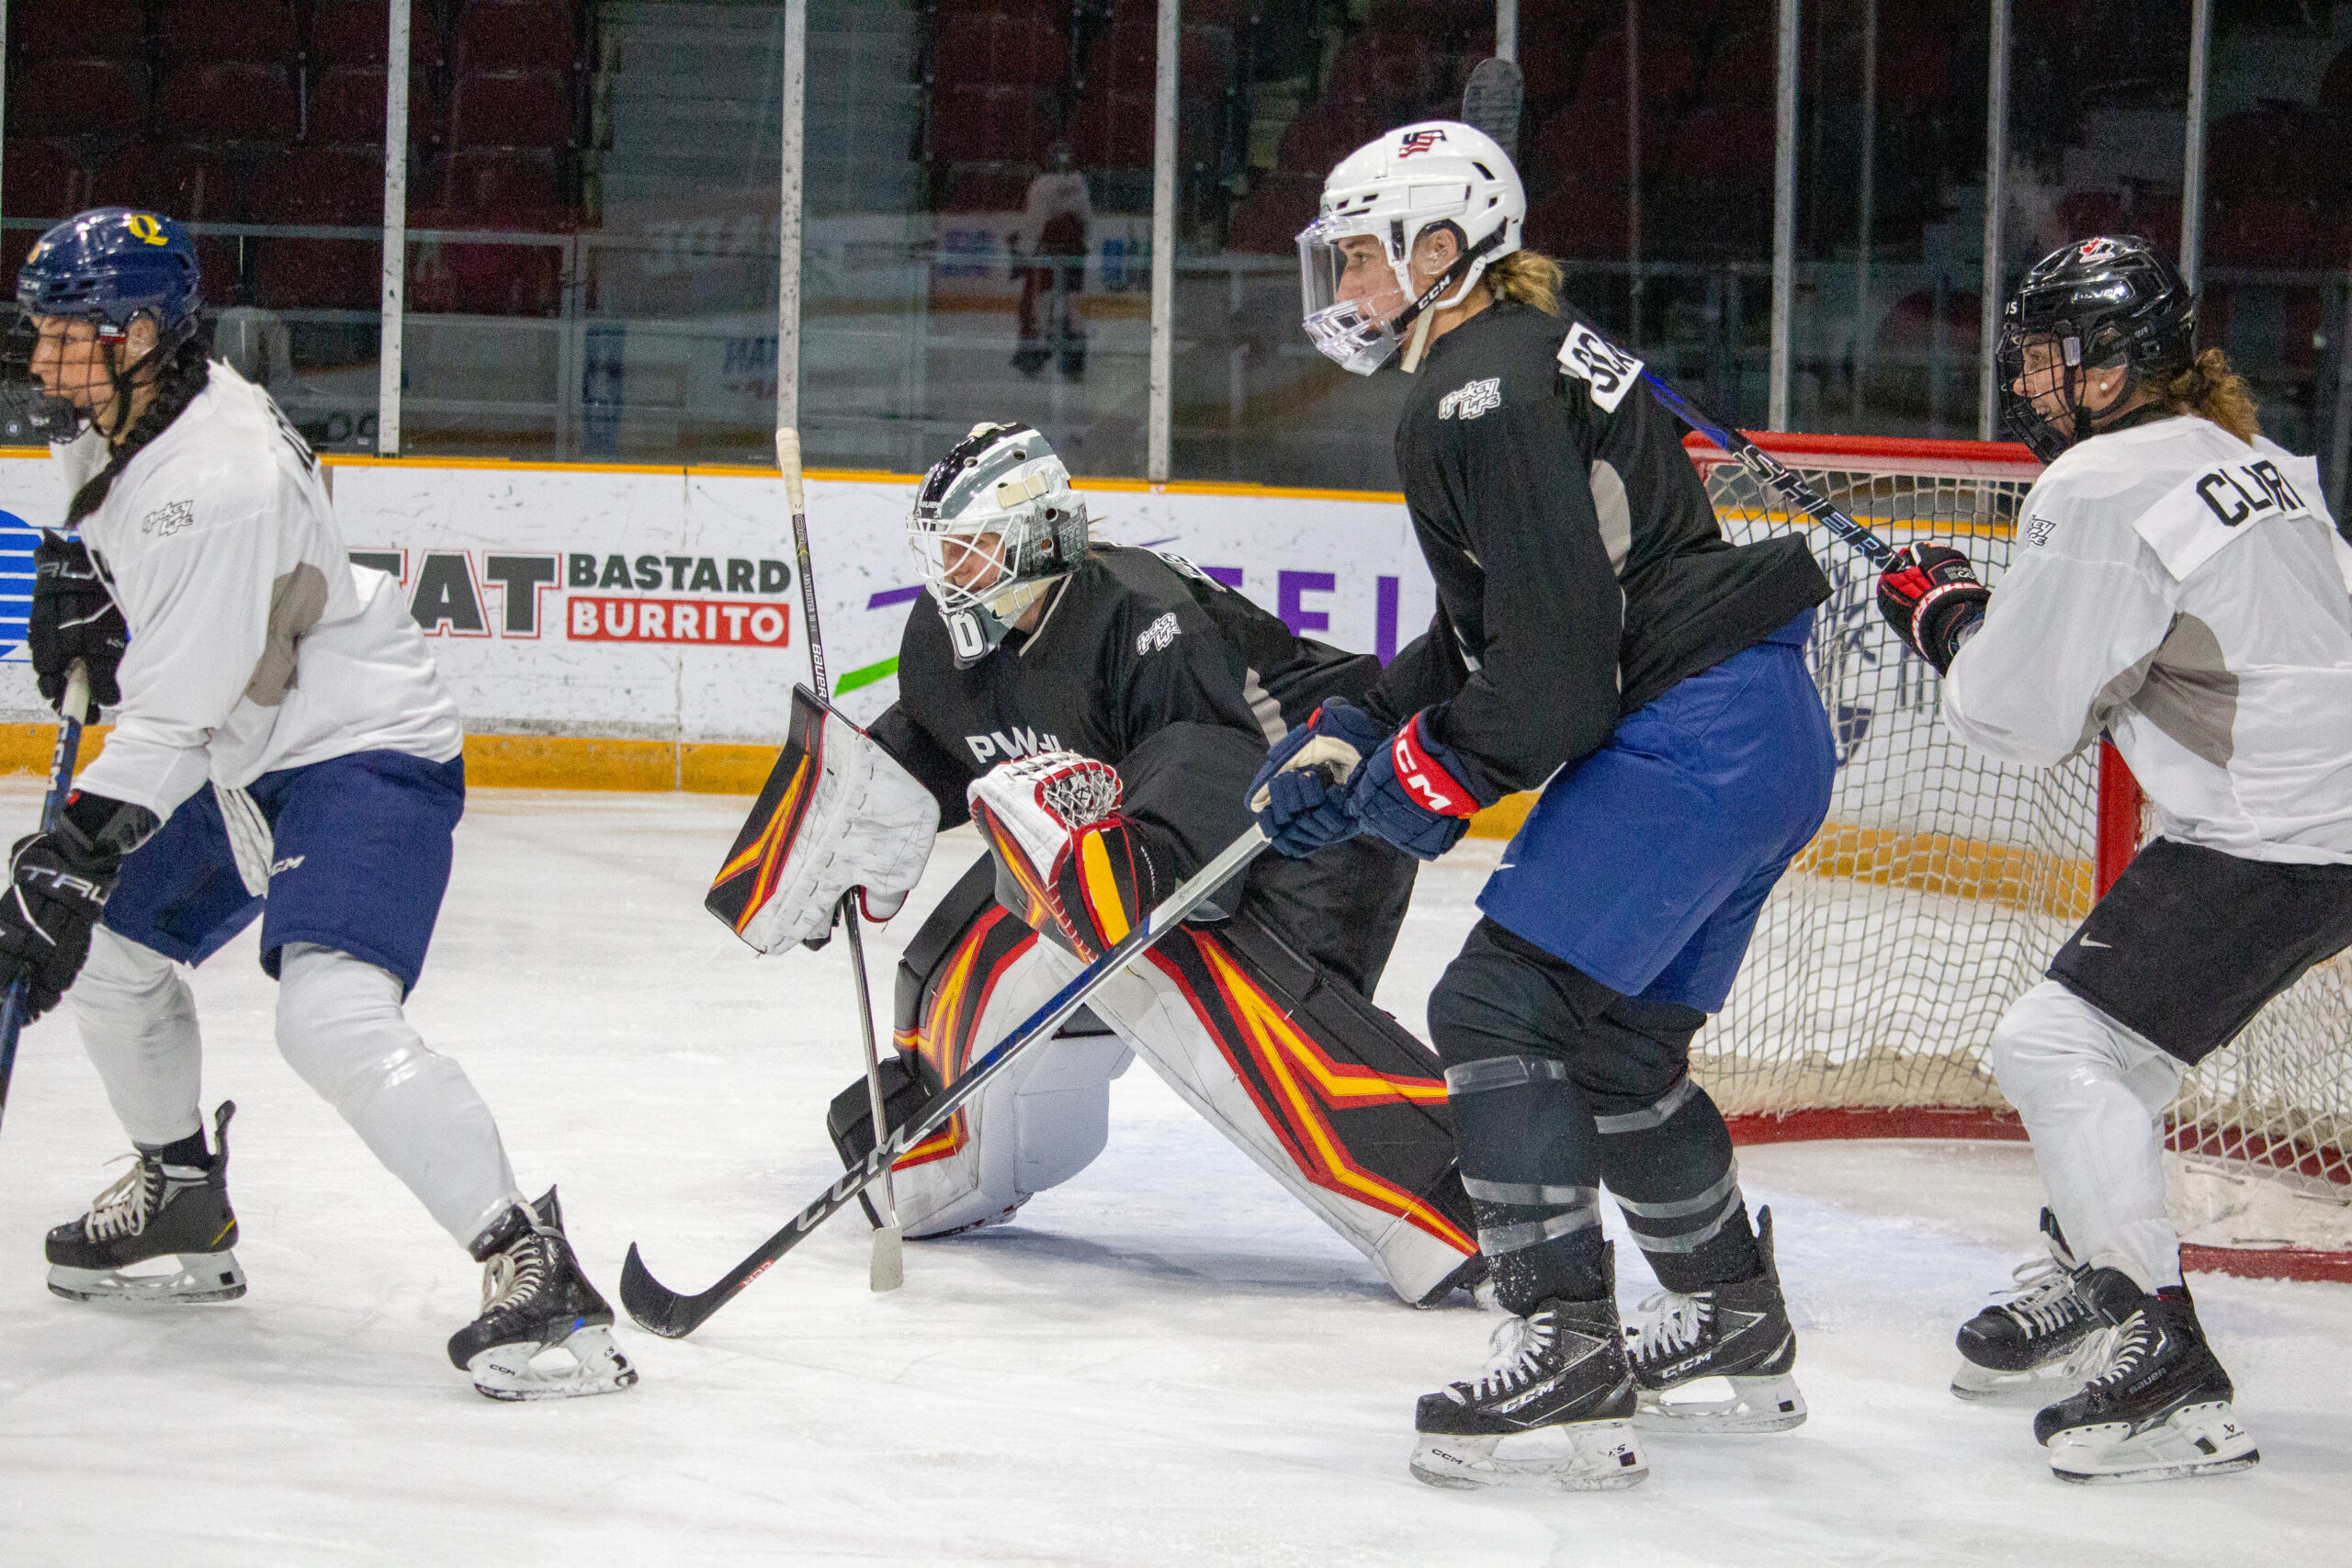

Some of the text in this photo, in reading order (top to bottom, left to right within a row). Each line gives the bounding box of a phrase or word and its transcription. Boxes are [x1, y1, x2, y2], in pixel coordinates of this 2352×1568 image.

[127, 214, 169, 246] Q
[1418, 274, 1451, 310] CCM
[348, 549, 791, 639] AT BASTARD
[572, 601, 786, 642] BURRITO
[811, 643, 828, 699] BAUER
[797, 1122, 906, 1232] CCM
[489, 1363, 516, 1376] CCM
[1661, 1350, 1713, 1379] CCM
[2128, 1367, 2168, 1394] BAUER
[1500, 1381, 1555, 1414] CCM
[1431, 1449, 1464, 1464] CCM
